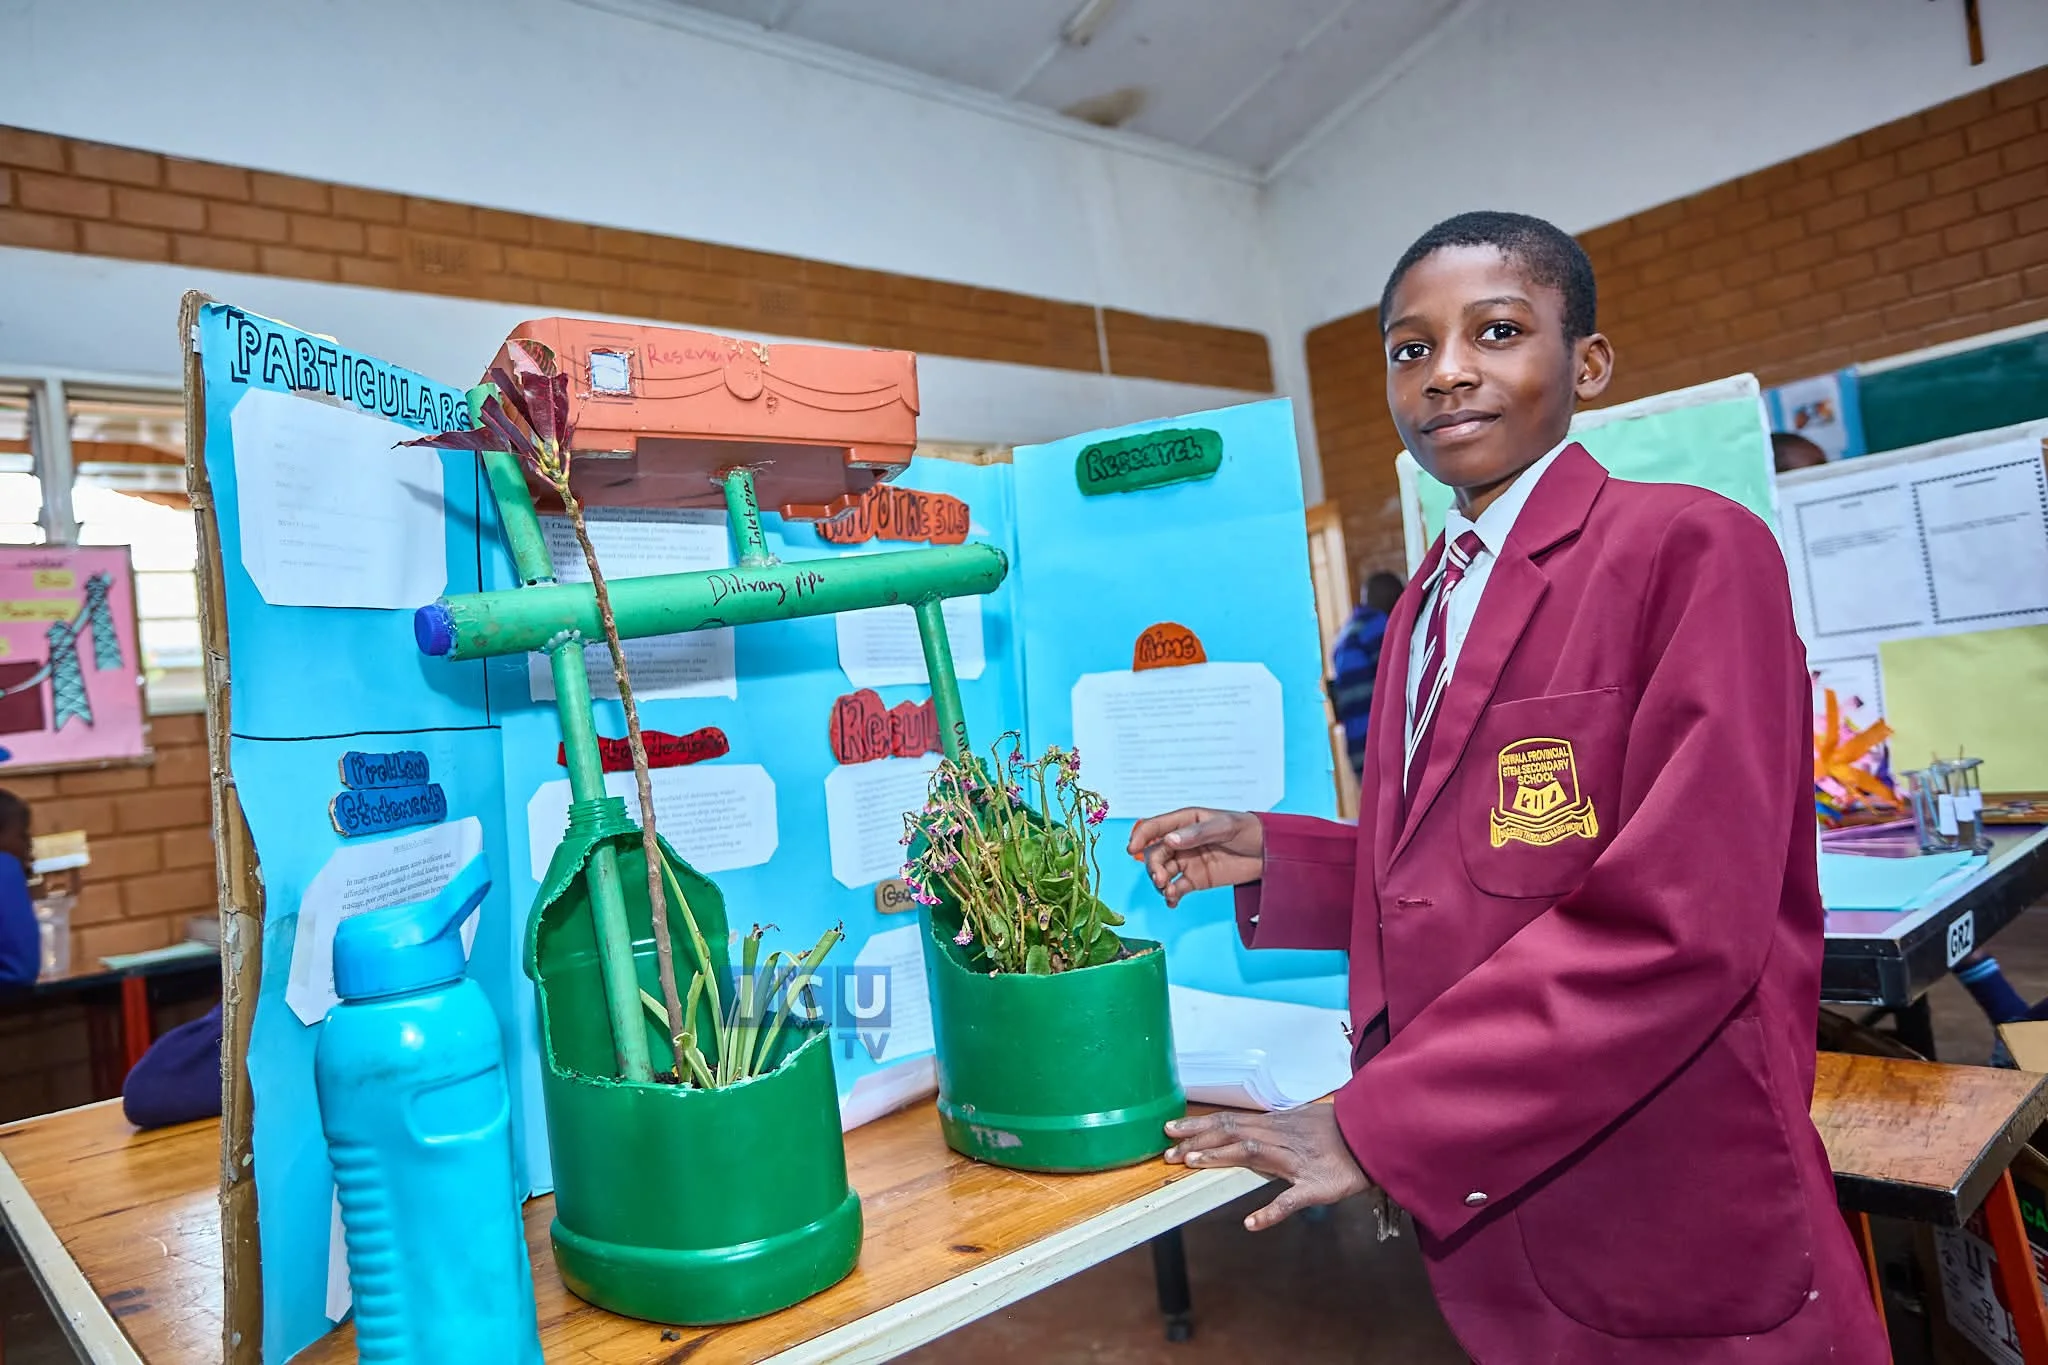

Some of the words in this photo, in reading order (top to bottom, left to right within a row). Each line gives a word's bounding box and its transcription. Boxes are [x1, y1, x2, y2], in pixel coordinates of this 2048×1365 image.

[237, 319, 471, 432] PARTICULARS
[1086, 436, 1203, 482] Research
[744, 510, 762, 548] Inlet
[839, 698, 938, 761] Resul
[1521, 759, 1569, 774] SECONDARY
[1527, 747, 1569, 761] PROVINCIAL
[1518, 772, 1557, 785] SCHOOL
[342, 783, 441, 830] Statement
[1951, 918, 1971, 958] GRZ
